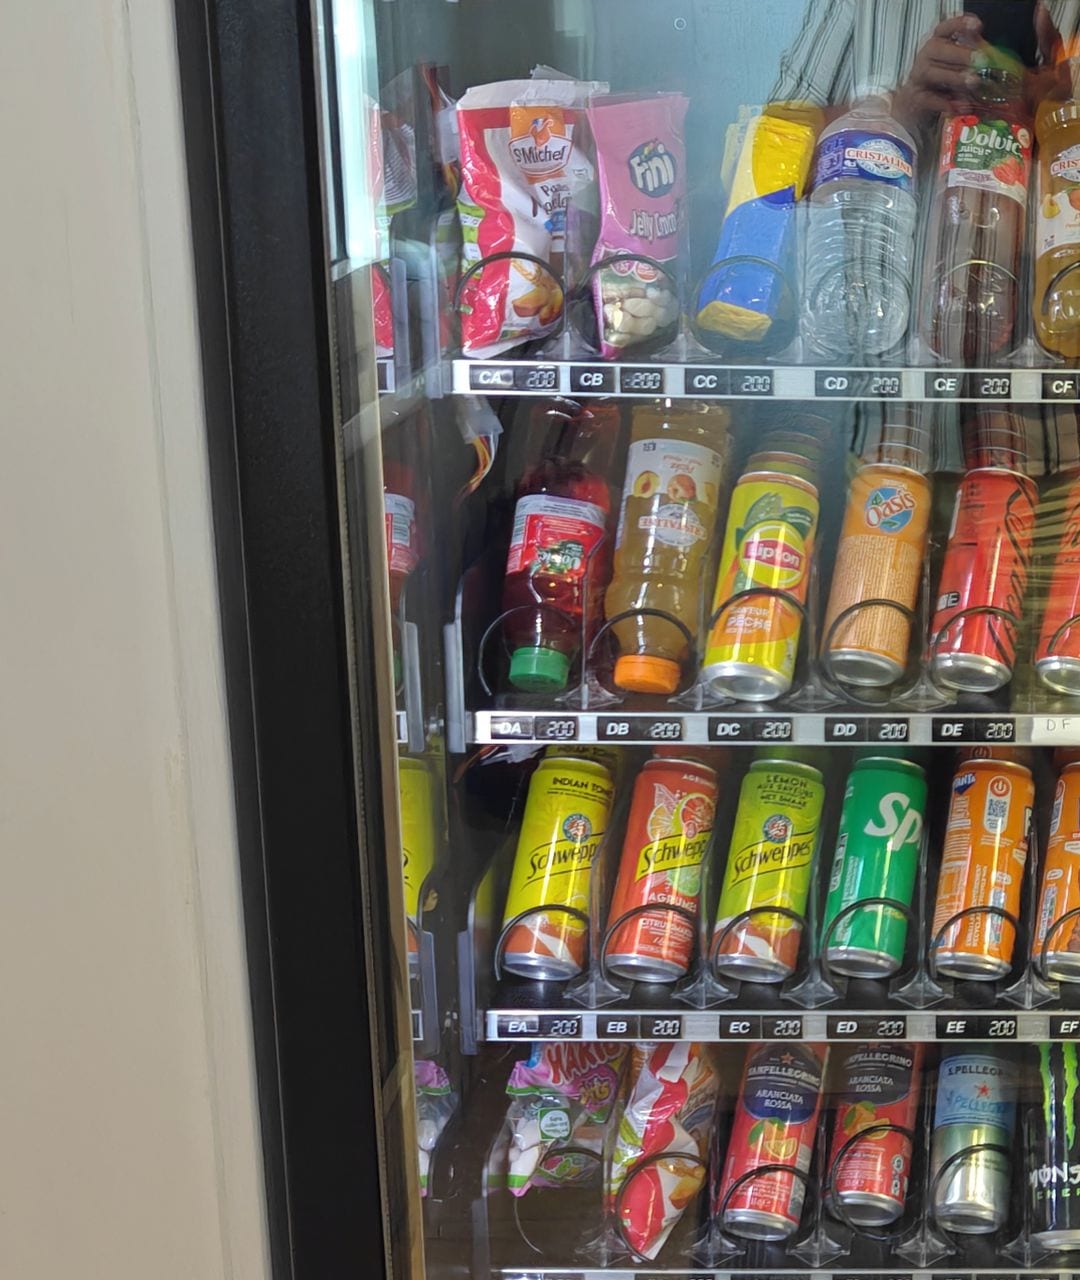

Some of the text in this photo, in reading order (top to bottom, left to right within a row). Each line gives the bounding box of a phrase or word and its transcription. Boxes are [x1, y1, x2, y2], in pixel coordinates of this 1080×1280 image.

[959, 125, 1024, 158] Volvic
[630, 143, 675, 192] Fini
[478, 371, 501, 384] CA
[579, 373, 603, 386] CB
[632, 372, 660, 389] 200
[692, 375, 717, 389] CC
[742, 375, 771, 392] 200
[823, 376, 848, 390] CD
[872, 377, 899, 393] 200
[934, 378, 957, 391] CE
[981, 378, 1009, 395] 200
[1052, 380, 1074, 393] CF
[866, 491, 917, 528] Oasis
[547, 721, 575, 737] 200
[606, 723, 629, 735] DB
[652, 723, 681, 738] 200
[716, 723, 741, 735] DC
[762, 723, 791, 738] 200
[833, 724, 857, 736] DD
[879, 724, 908, 739] 200
[941, 723, 963, 736] DE
[986, 723, 1013, 738] 200
[552, 777, 589, 789] INDIAN
[732, 837, 815, 883] Schweppes
[507, 1022, 528, 1033] EA
[551, 1020, 578, 1036] 200
[607, 1022, 628, 1033] EB
[652, 1020, 681, 1036] 200
[729, 1023, 751, 1034] EC
[774, 1020, 801, 1036] 200
[836, 1022, 858, 1033] ED
[877, 1021, 904, 1036] 200
[946, 1022, 967, 1033] EE
[988, 1020, 1015, 1036] 200
[1060, 1022, 1080, 1033] EF
